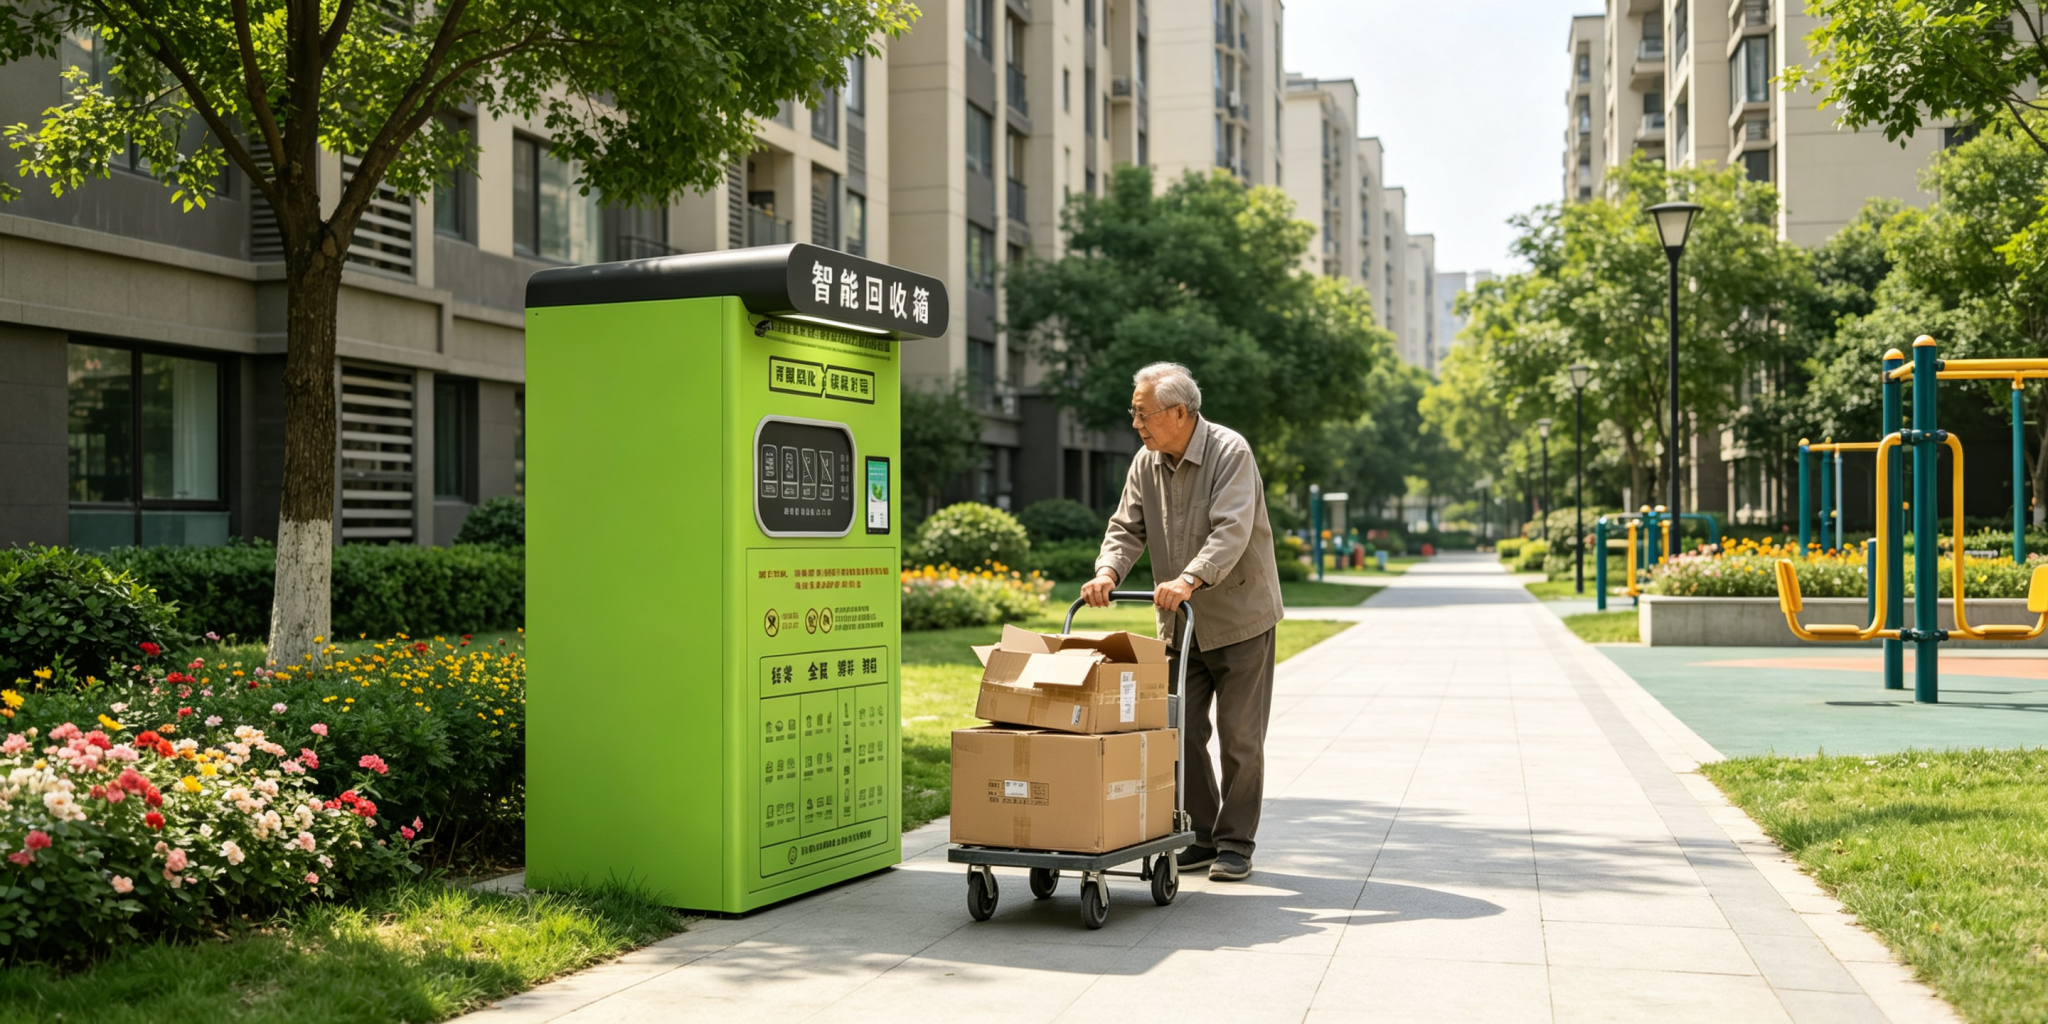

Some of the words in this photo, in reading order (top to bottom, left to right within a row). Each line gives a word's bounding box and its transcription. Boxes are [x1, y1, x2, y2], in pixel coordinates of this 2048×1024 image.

[812, 261, 929, 324] 智能回收箱
